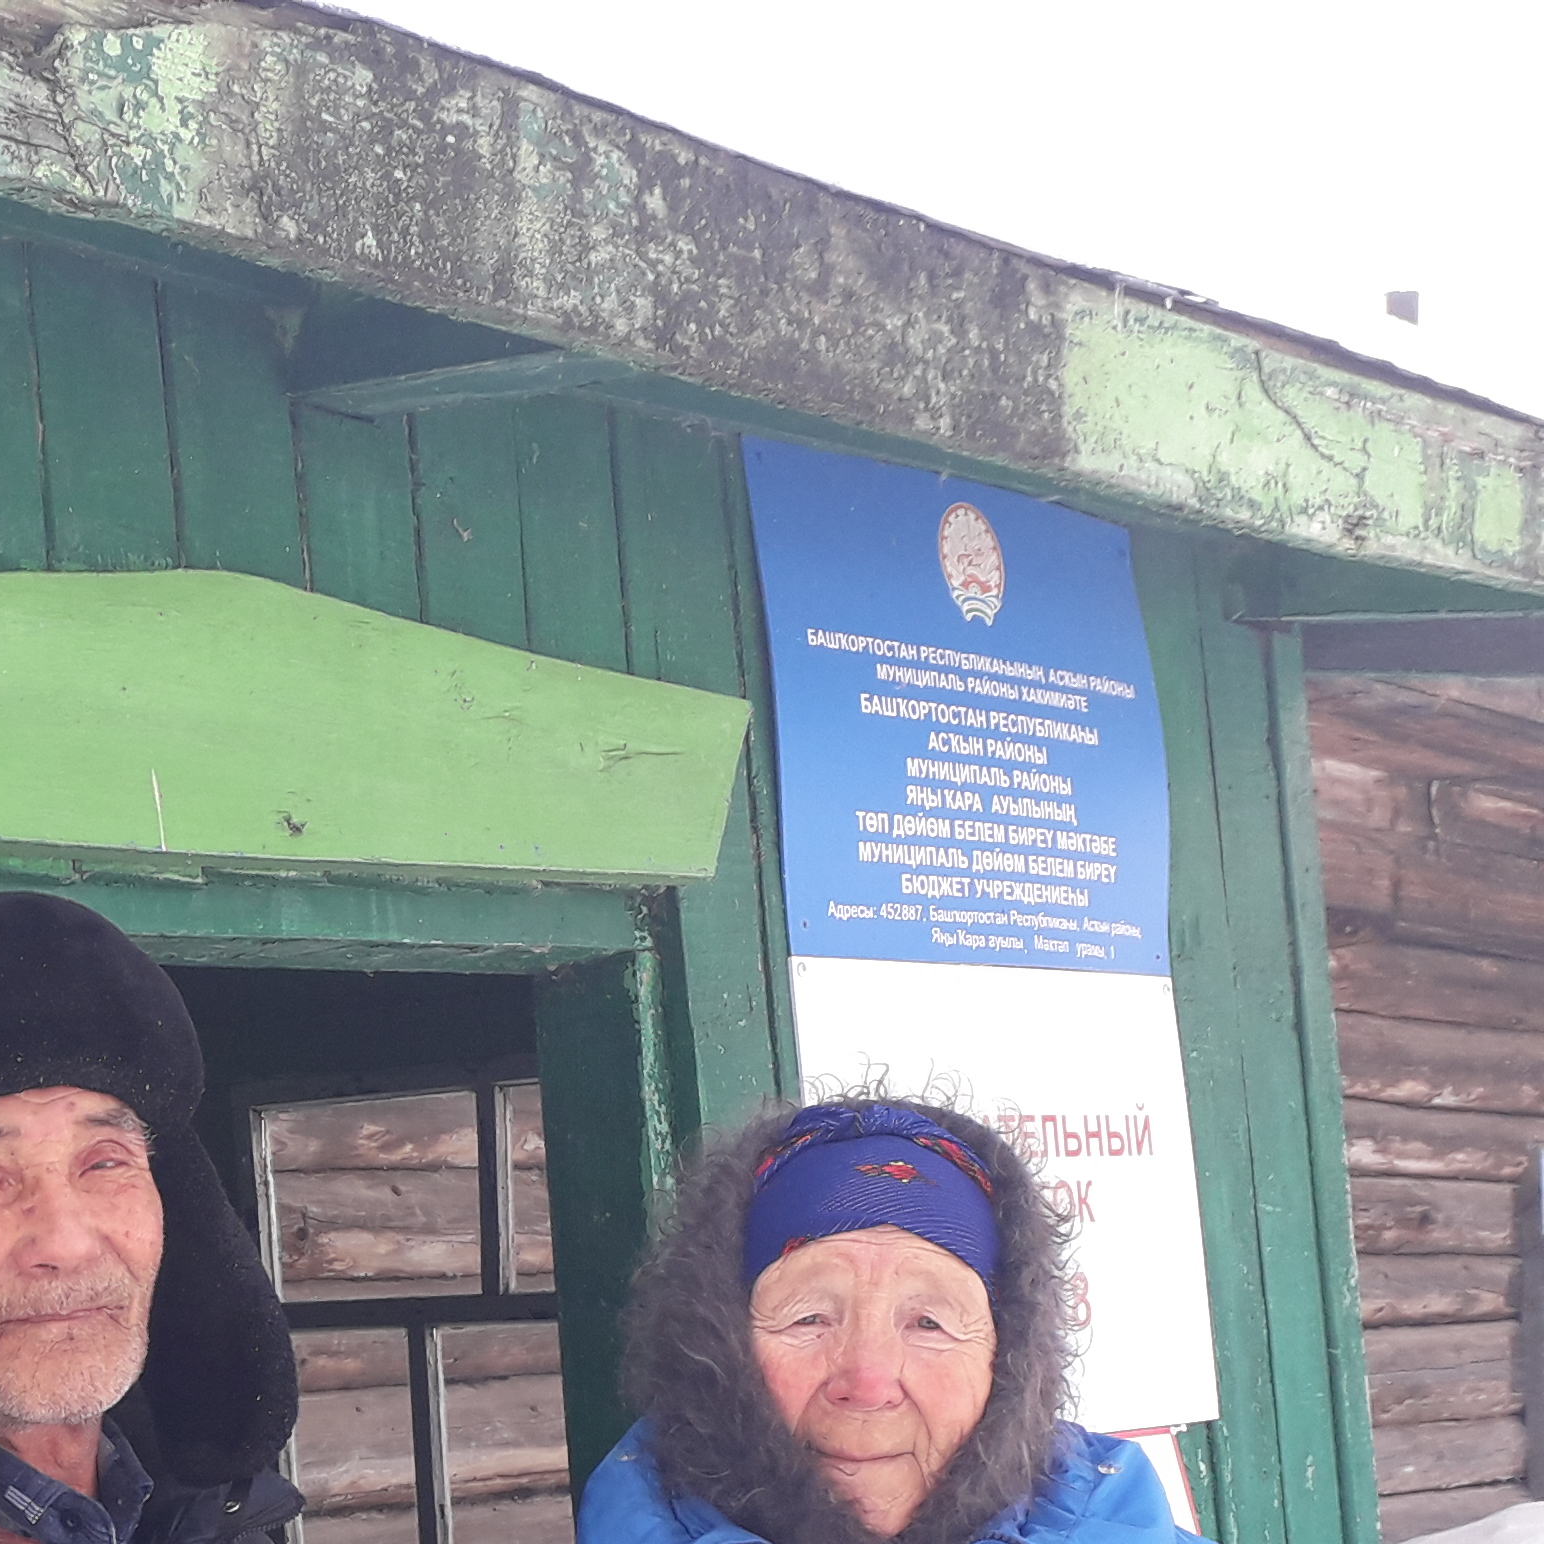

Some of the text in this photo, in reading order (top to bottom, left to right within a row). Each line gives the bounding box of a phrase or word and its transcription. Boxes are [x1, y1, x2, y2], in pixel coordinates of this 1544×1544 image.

[876, 663, 964, 692] МУНИЦИПАЛЬ
[967, 675, 1019, 699] РАЙОНЫ
[860, 693, 987, 729] БАШҠОРТОСТАН
[986, 733, 1048, 765] РАЙОНЫ
[906, 758, 1072, 795] МУНИЦИПАЛЬ РАЙОНЫ
[906, 785, 941, 810] ЯҢЫ
[856, 811, 889, 834] ТӨП
[954, 820, 1005, 843] БЕЛЕМ
[858, 842, 968, 869] МУНИЦИПАЛЬ
[1028, 856, 1073, 878] БЕЛЕМ
[902, 873, 1088, 907] БЮДЖЕТ УЧРЕЖДЕНИЕҺЫ
[828, 901, 877, 921] Адресы:
[982, 1102, 1154, 1158] ТЕЛЬНЫЙ
